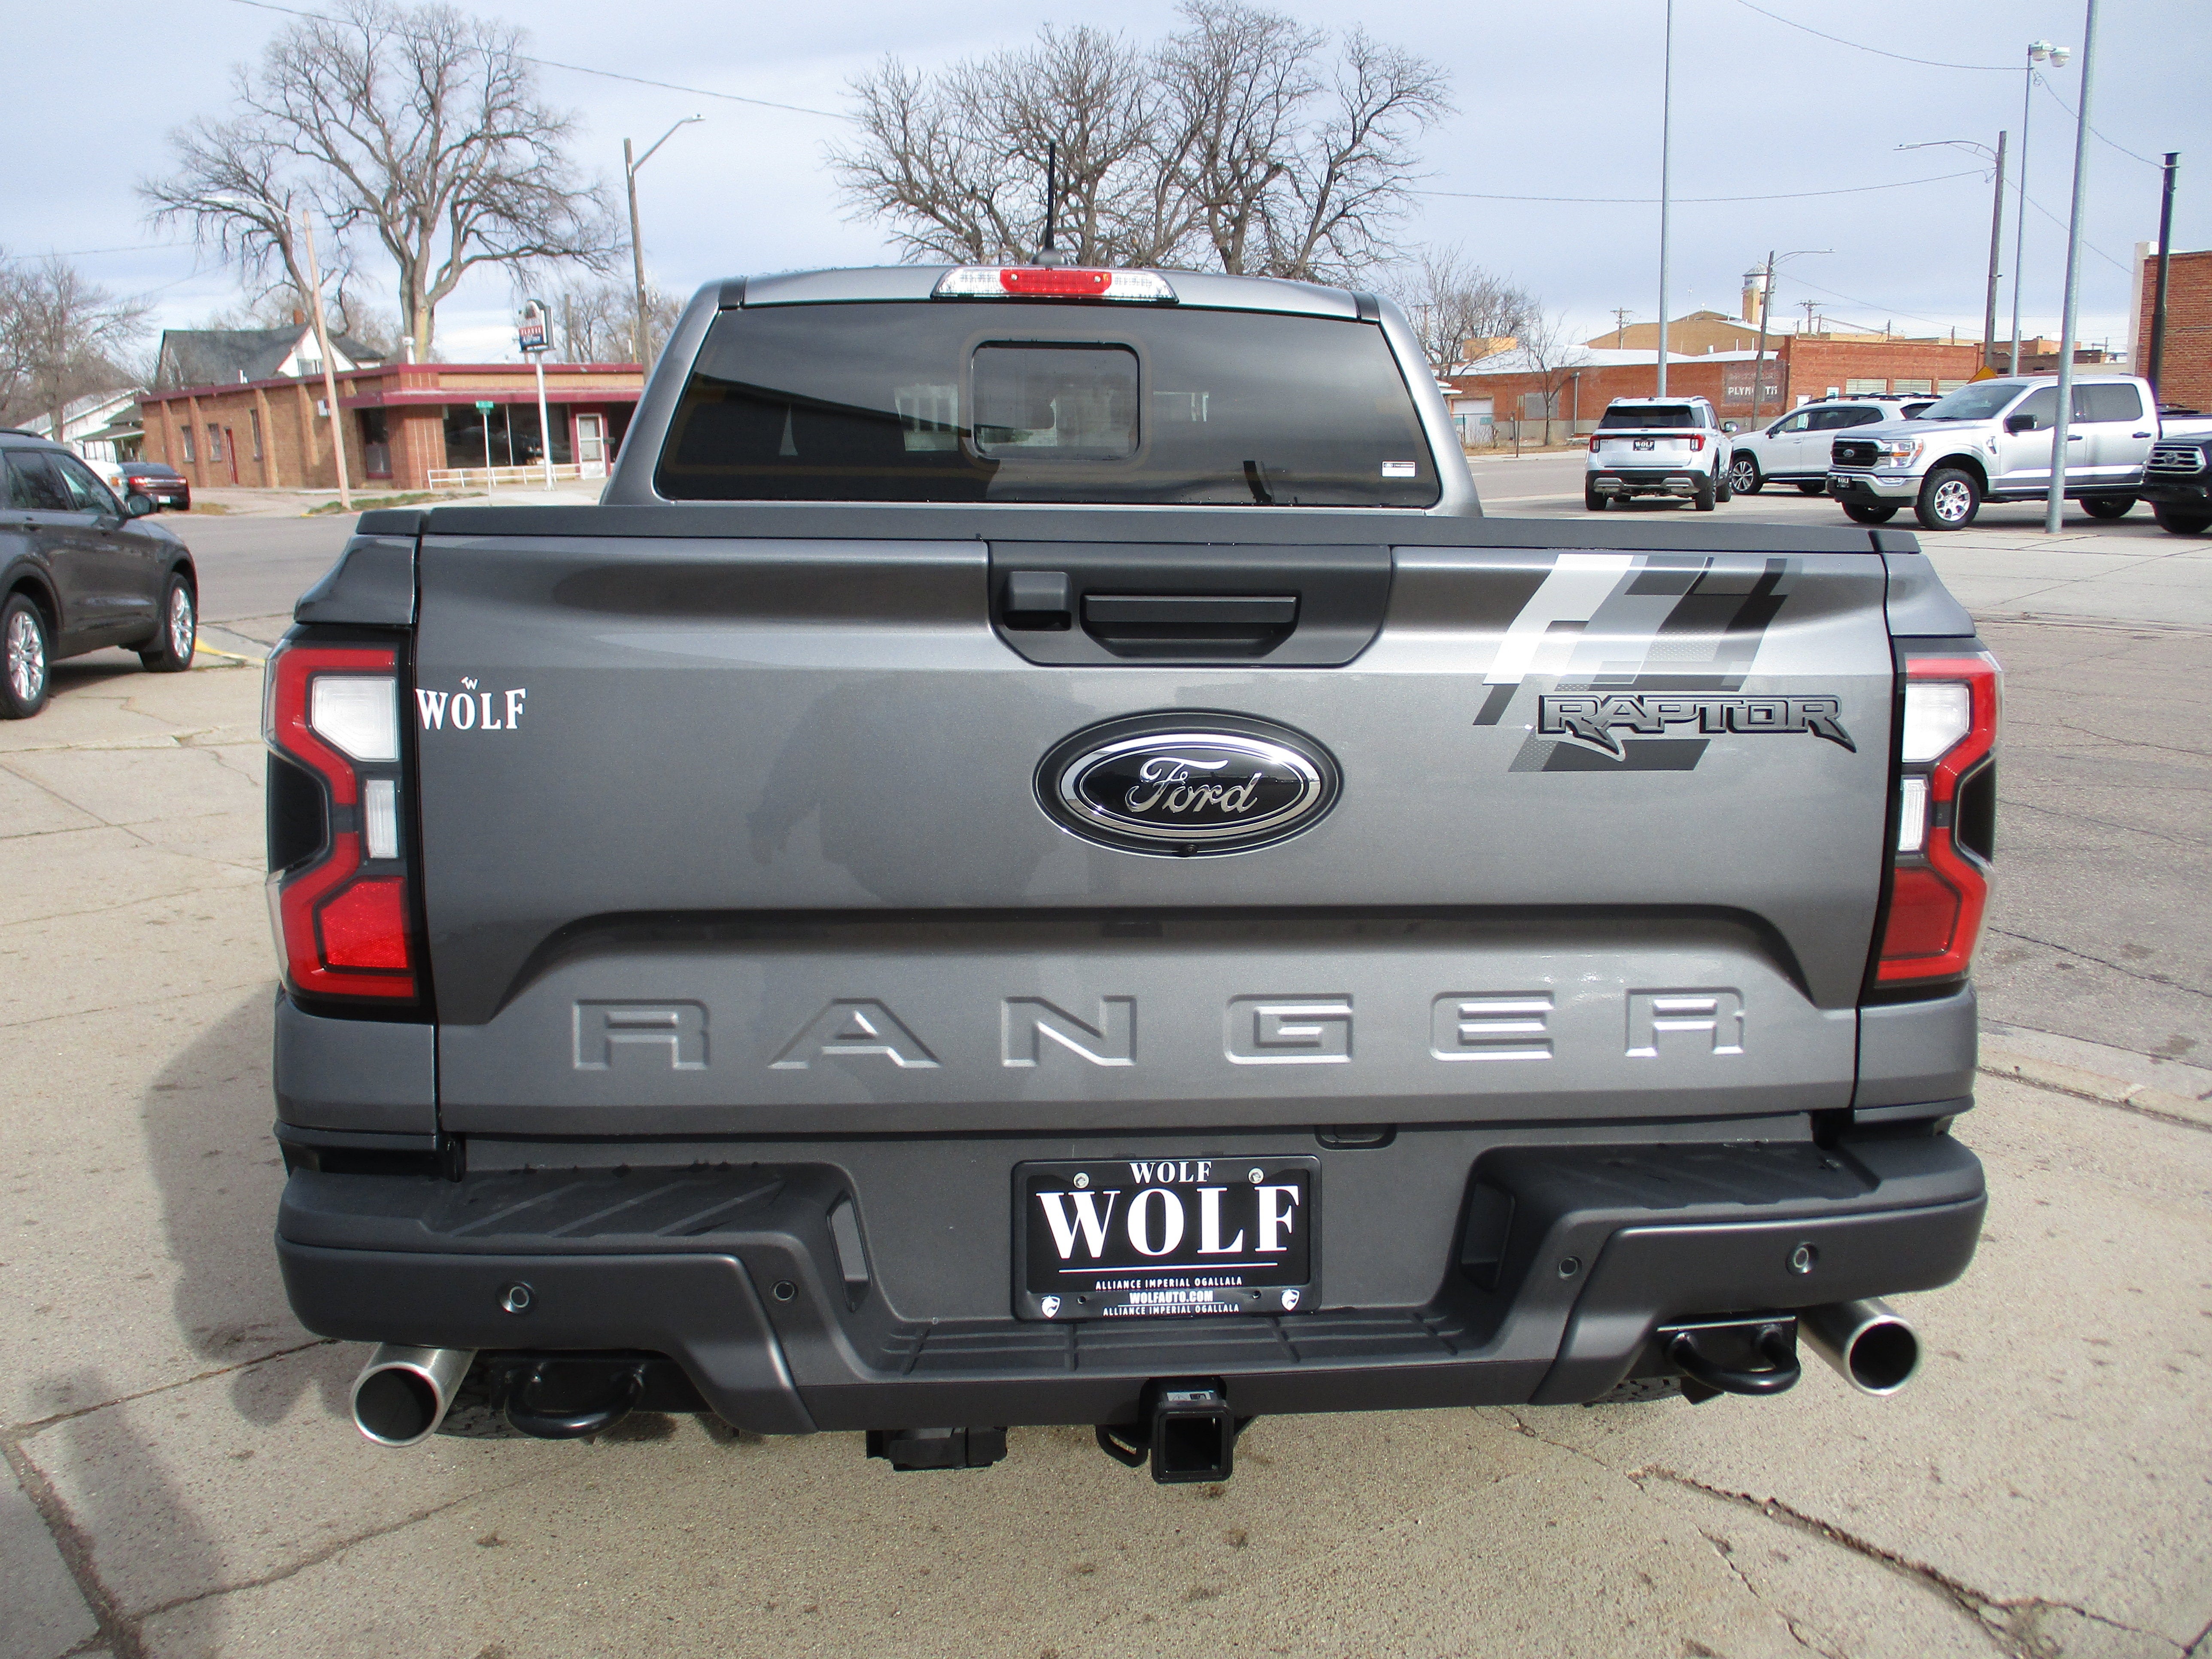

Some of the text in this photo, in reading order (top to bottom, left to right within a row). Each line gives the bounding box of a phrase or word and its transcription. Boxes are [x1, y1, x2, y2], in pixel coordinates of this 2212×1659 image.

[1728, 386, 1778, 395] PLYMTH
[415, 688, 527, 730] WOLF
[1538, 694, 1856, 754] RAPTOR
[1124, 757, 1262, 813] Ford
[572, 986, 1746, 1071] RANGER
[1129, 1161, 1212, 1184] WOLF
[1035, 1185, 1300, 1259] WOLF
[1096, 1276, 1242, 1290] ALLIANCE IMPERIAL OGALLALA
[1129, 1290, 1213, 1304] WOLFAUTO.COM
[1103, 1304, 1239, 1316] ALLIANCE IMPERIAL OGALLALA
